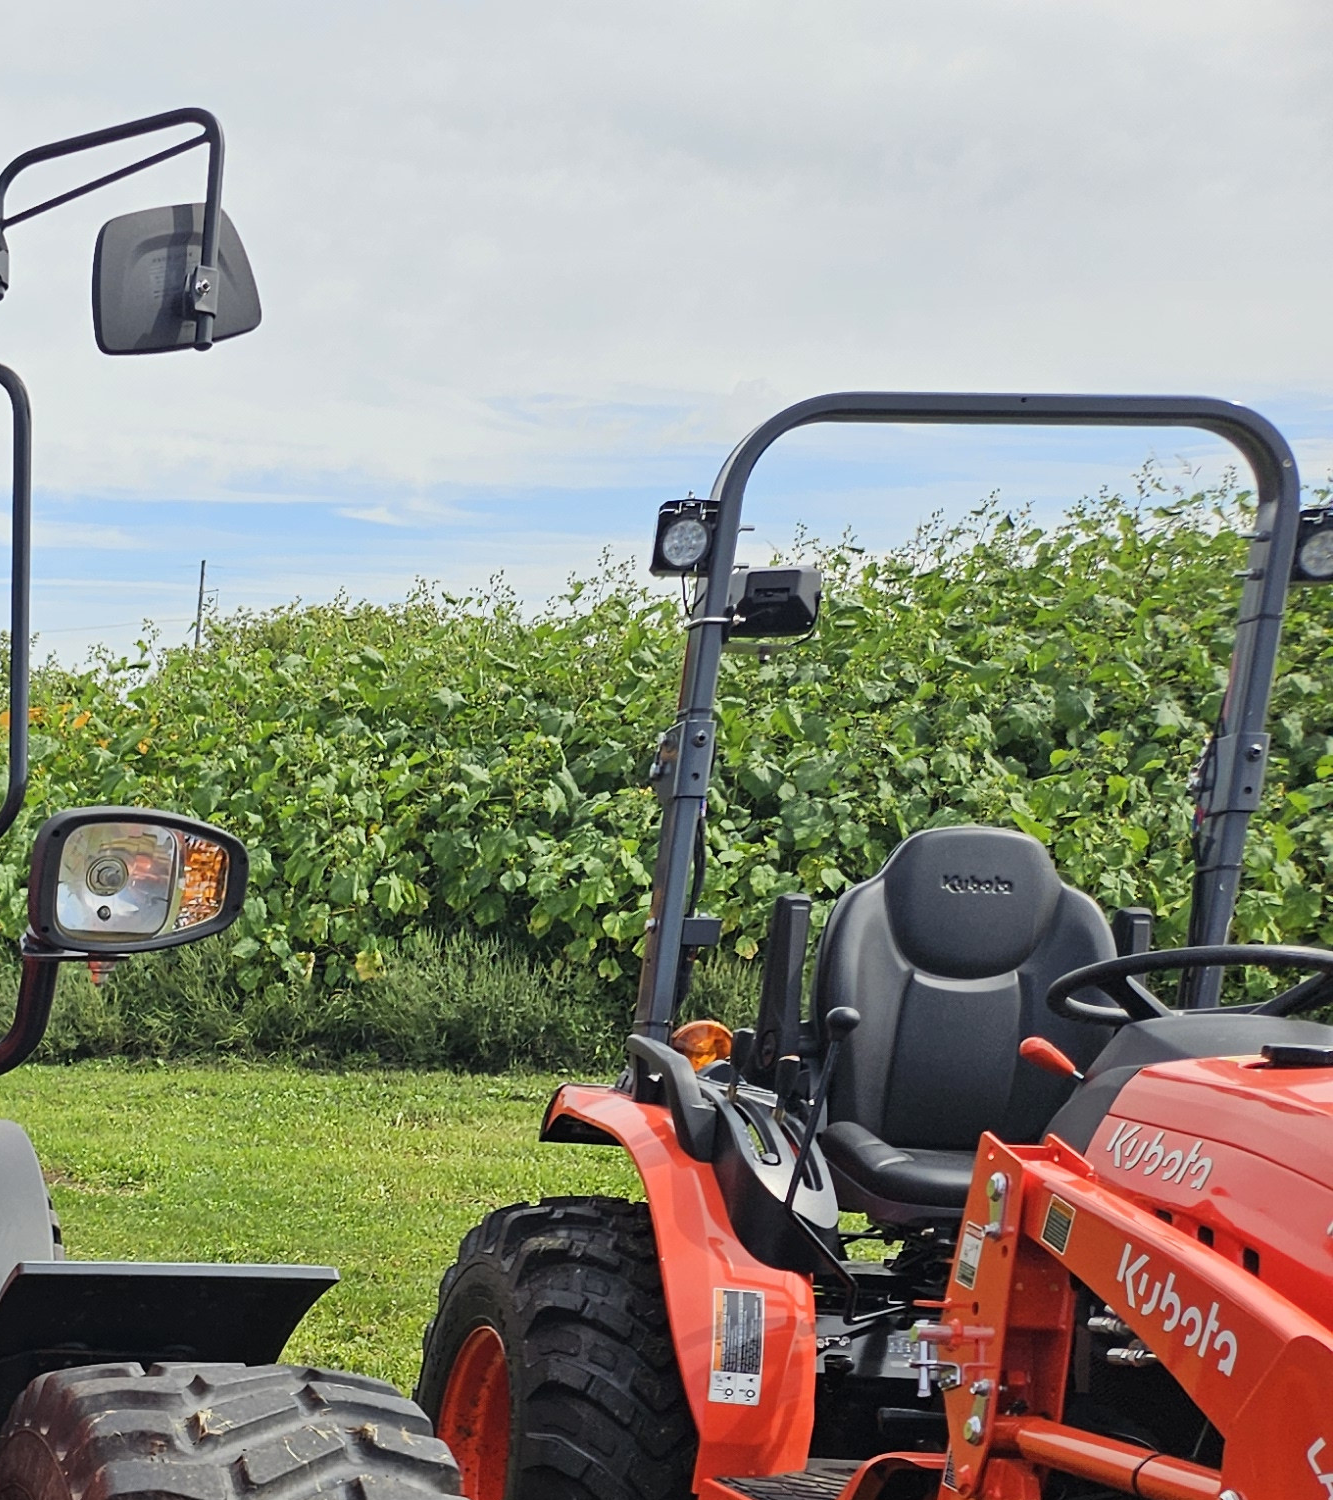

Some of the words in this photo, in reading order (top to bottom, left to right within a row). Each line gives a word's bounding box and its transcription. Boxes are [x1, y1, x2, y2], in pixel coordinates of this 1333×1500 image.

[941, 875, 1013, 895] Kubota
[1106, 1122, 1213, 1190] Kubota
[1116, 1242, 1237, 1377] Kubota
